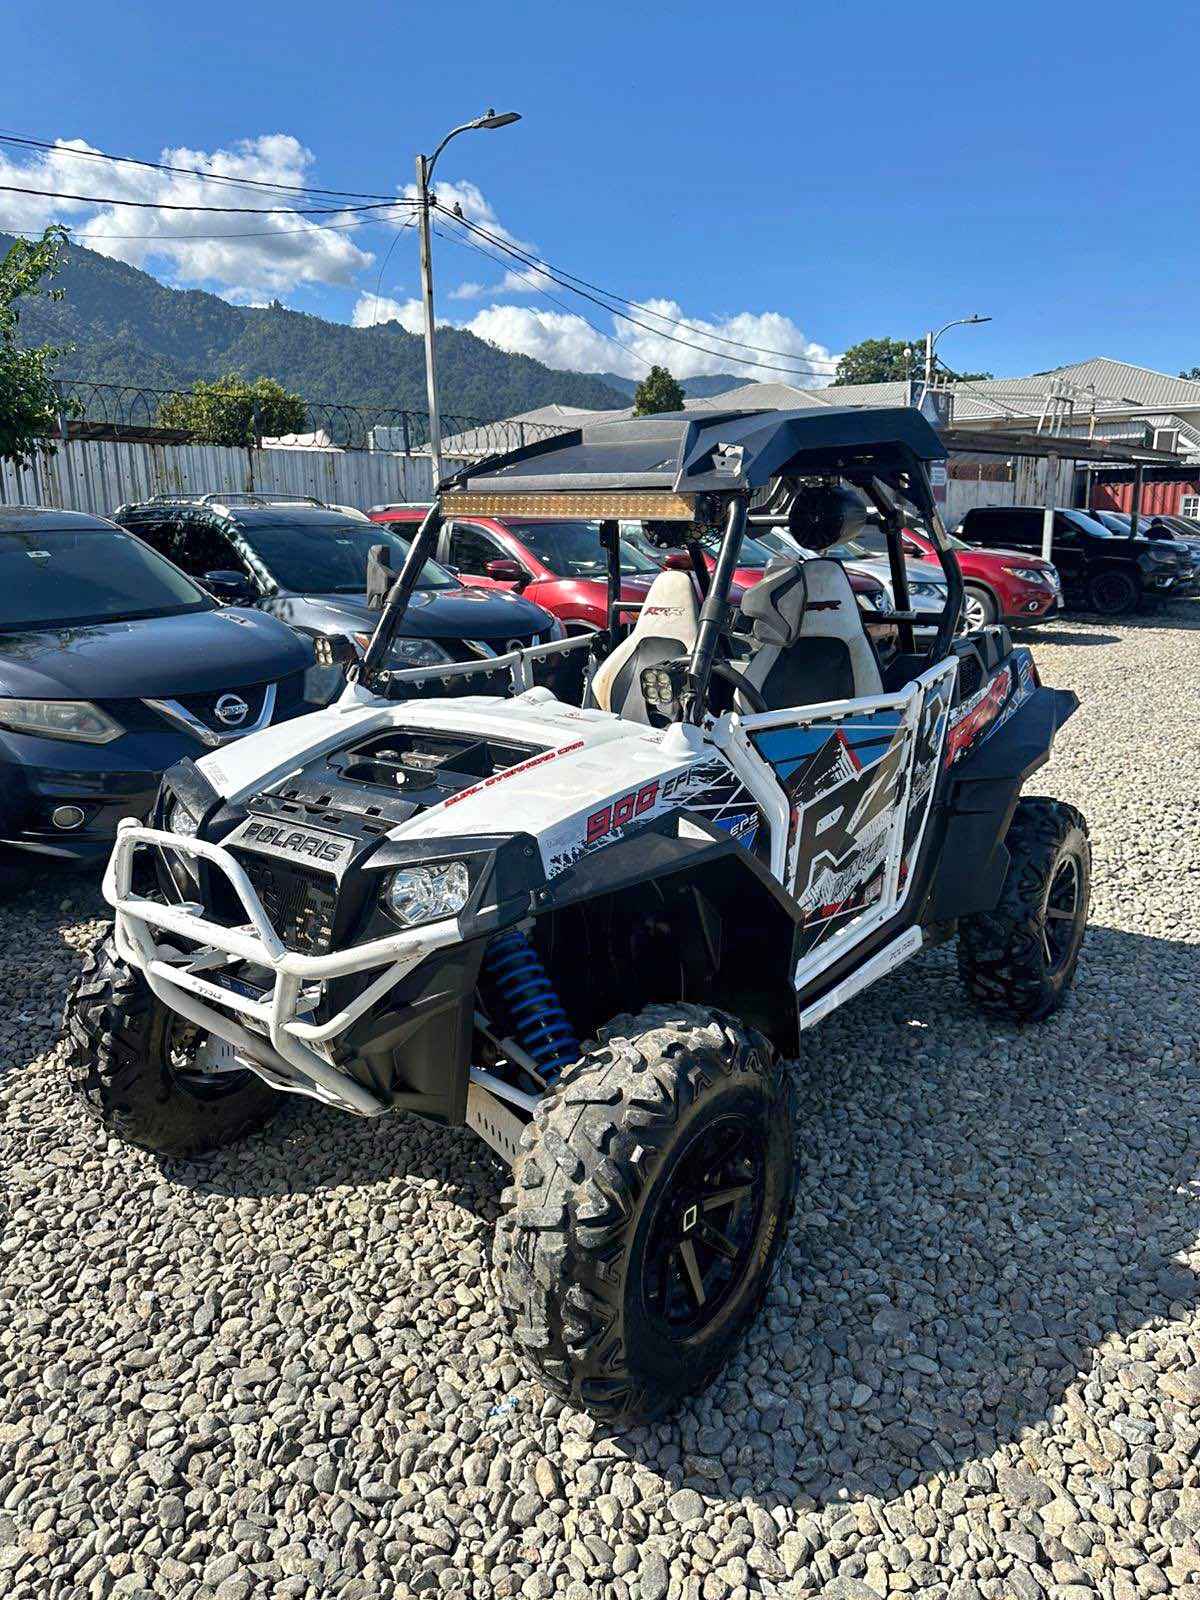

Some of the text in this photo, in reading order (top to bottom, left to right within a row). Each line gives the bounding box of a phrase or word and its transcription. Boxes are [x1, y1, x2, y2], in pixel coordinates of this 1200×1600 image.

[444, 740, 585, 808] DUAL OVERHEAD CAM
[586, 768, 692, 844] 900 EFI
[729, 811, 759, 836] EPS
[241, 822, 346, 862] POLARIS
